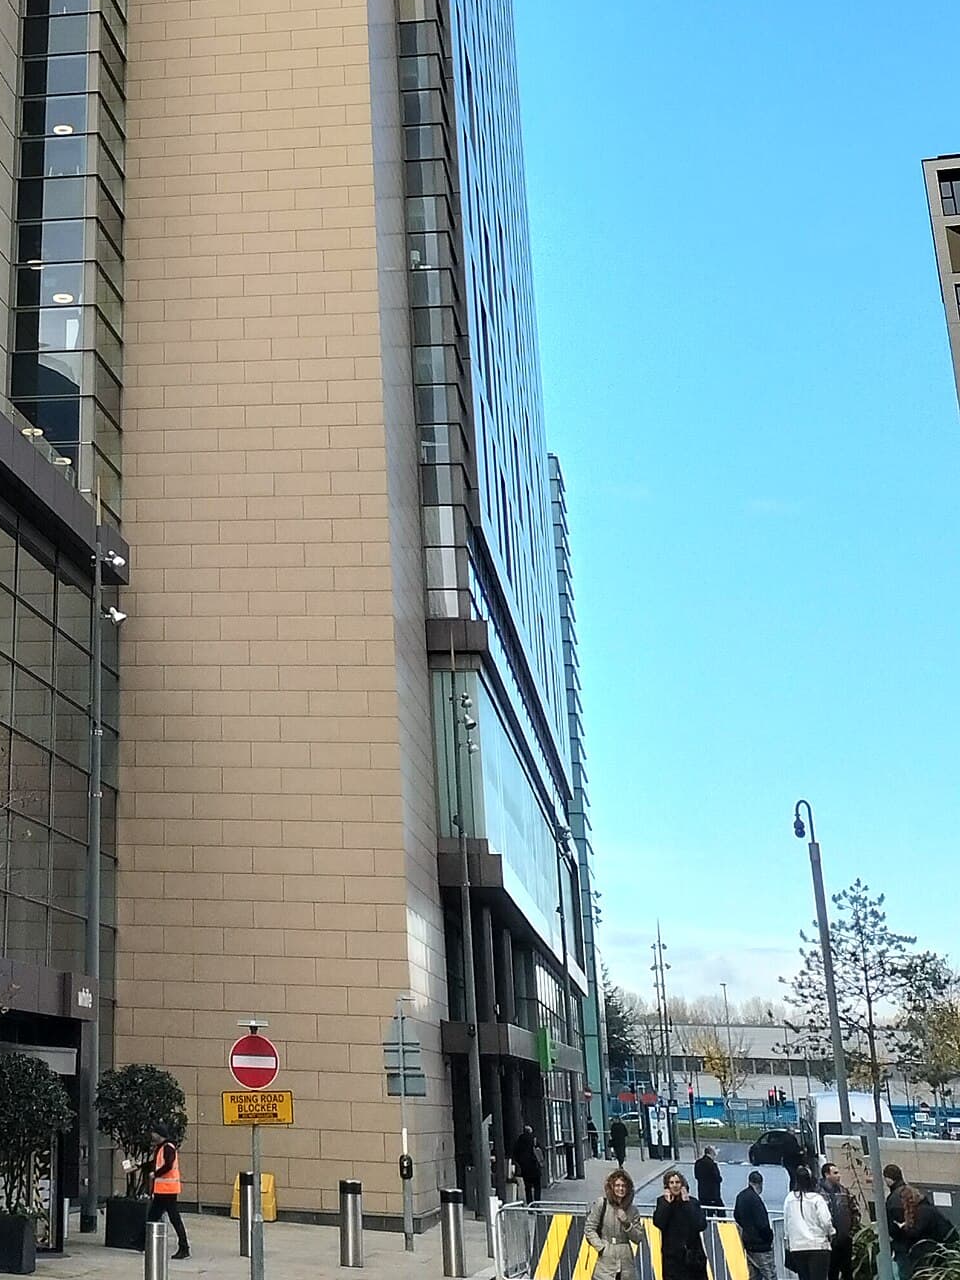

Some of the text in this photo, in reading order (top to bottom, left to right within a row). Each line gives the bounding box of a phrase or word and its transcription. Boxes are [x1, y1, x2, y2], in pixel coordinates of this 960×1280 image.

[230, 1094, 285, 1104] RISING ROAD
[237, 1103, 278, 1113] BLOCKER
